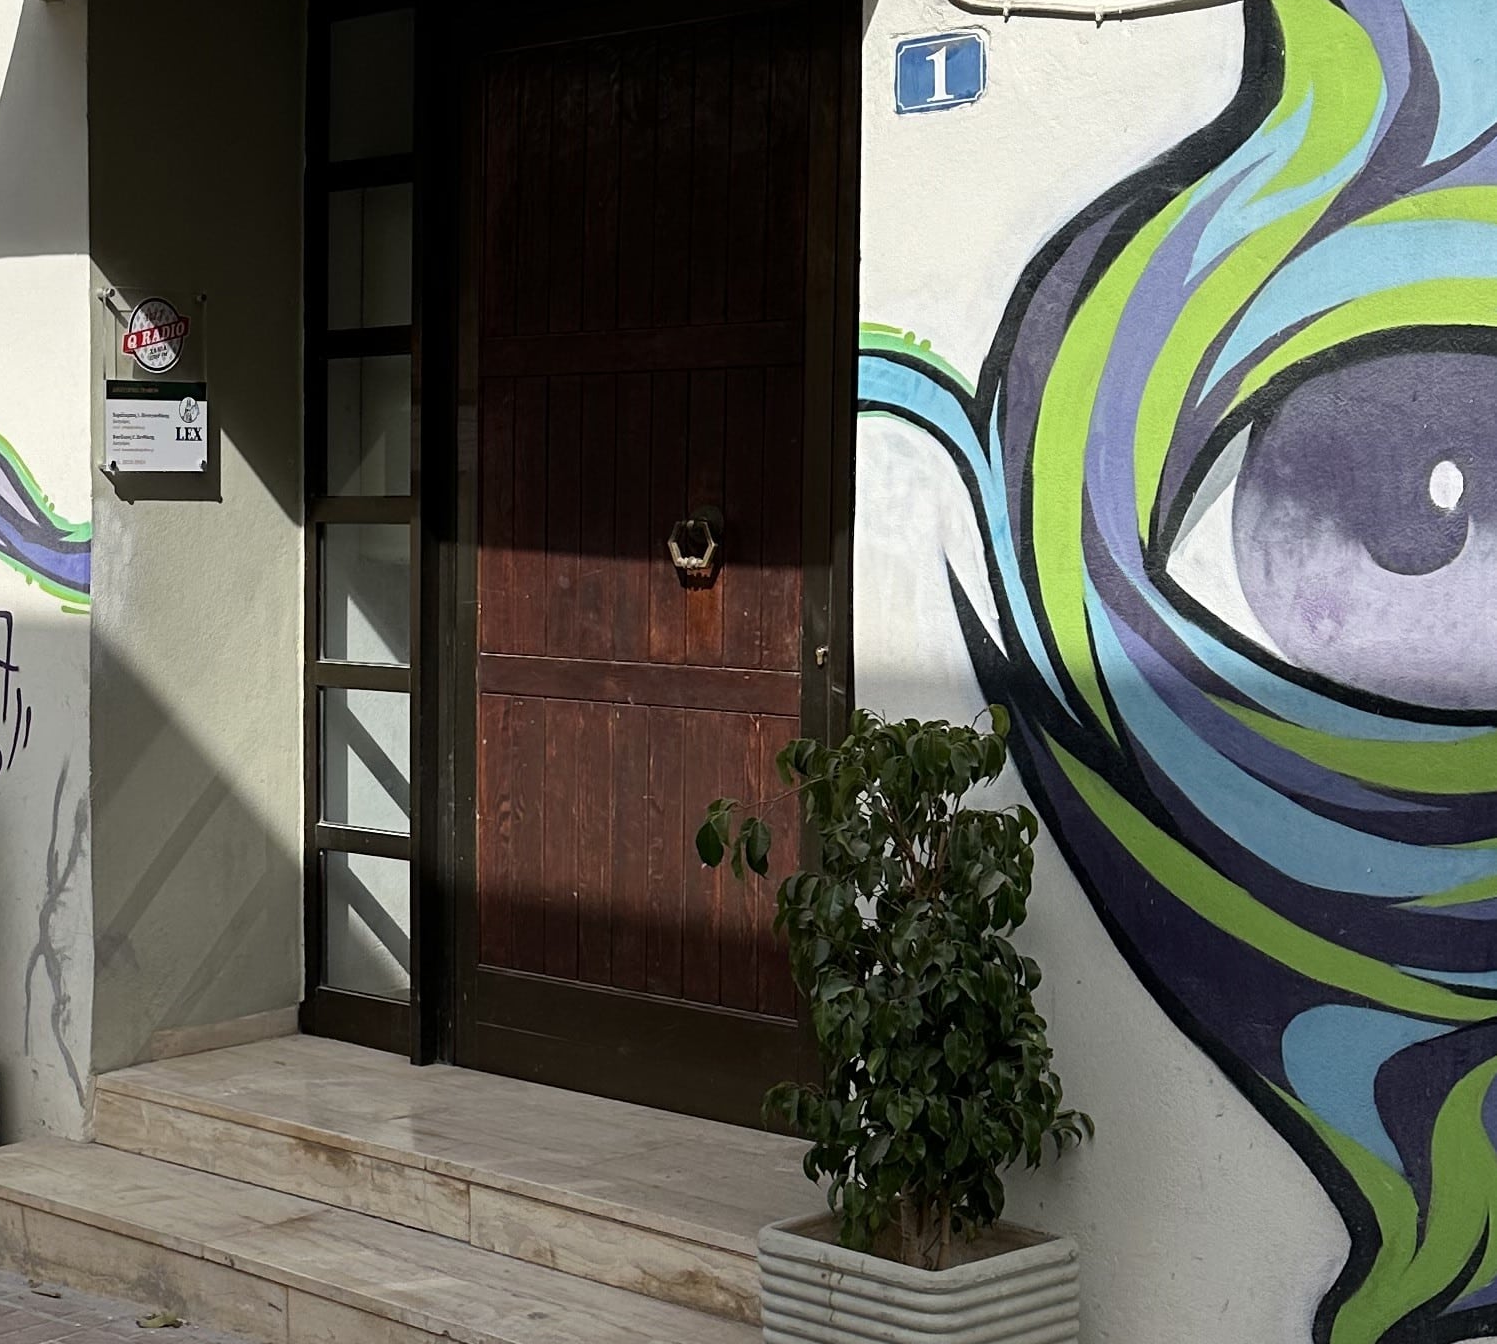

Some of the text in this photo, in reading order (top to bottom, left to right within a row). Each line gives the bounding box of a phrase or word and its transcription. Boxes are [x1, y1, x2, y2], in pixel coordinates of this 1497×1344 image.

[925, 45, 955, 103] 1
[141, 321, 185, 346] RADIO
[175, 426, 203, 441] LEX
